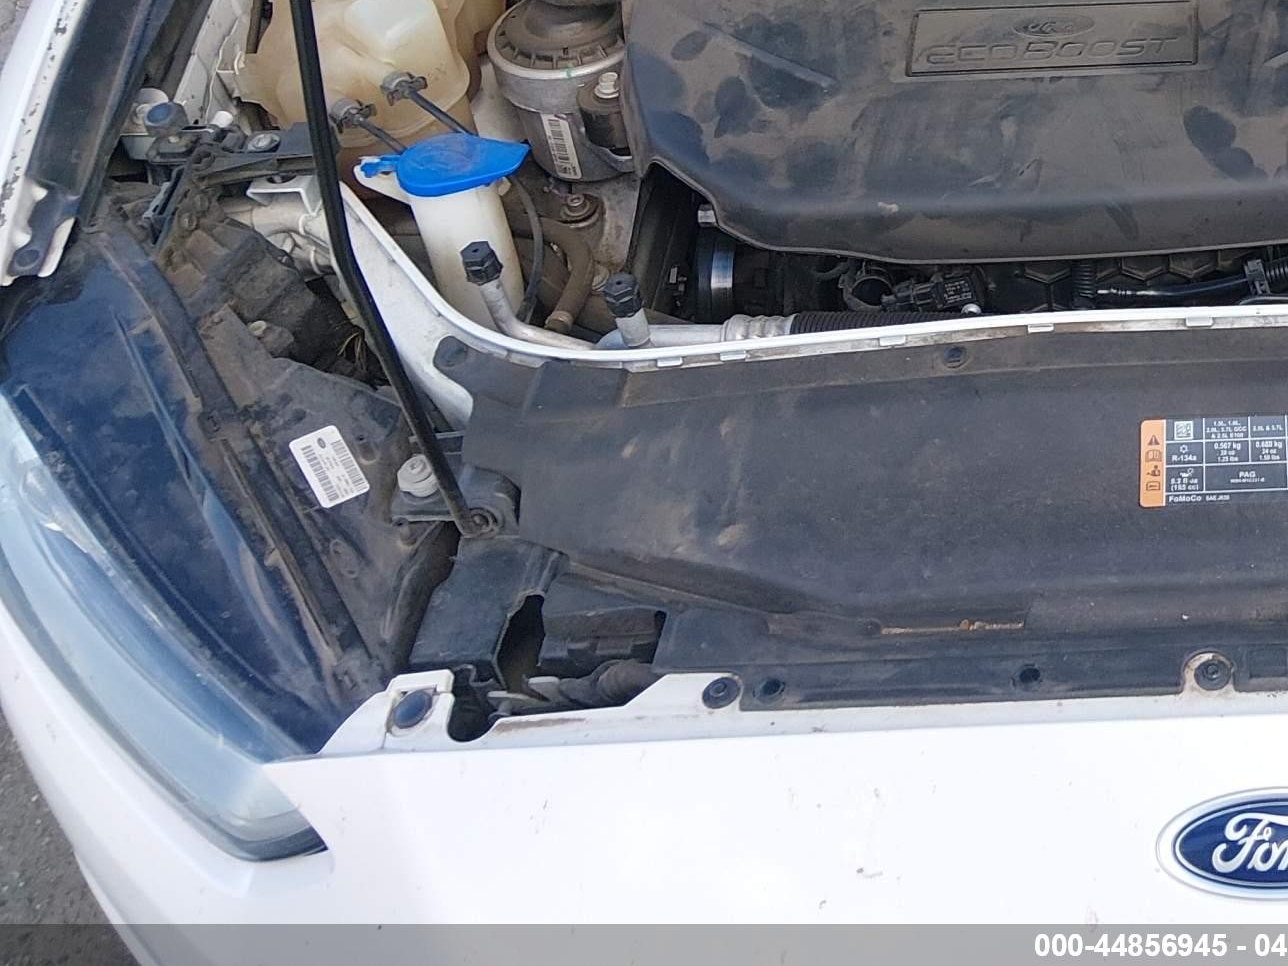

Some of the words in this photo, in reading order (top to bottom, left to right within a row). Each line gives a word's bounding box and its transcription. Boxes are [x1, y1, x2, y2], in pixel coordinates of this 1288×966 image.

[1232, 442, 1241, 450] kg
[1171, 454, 1197, 462] R-134a
[1238, 470, 1256, 478] PAG
[1168, 494, 1202, 503] FoMoCo
